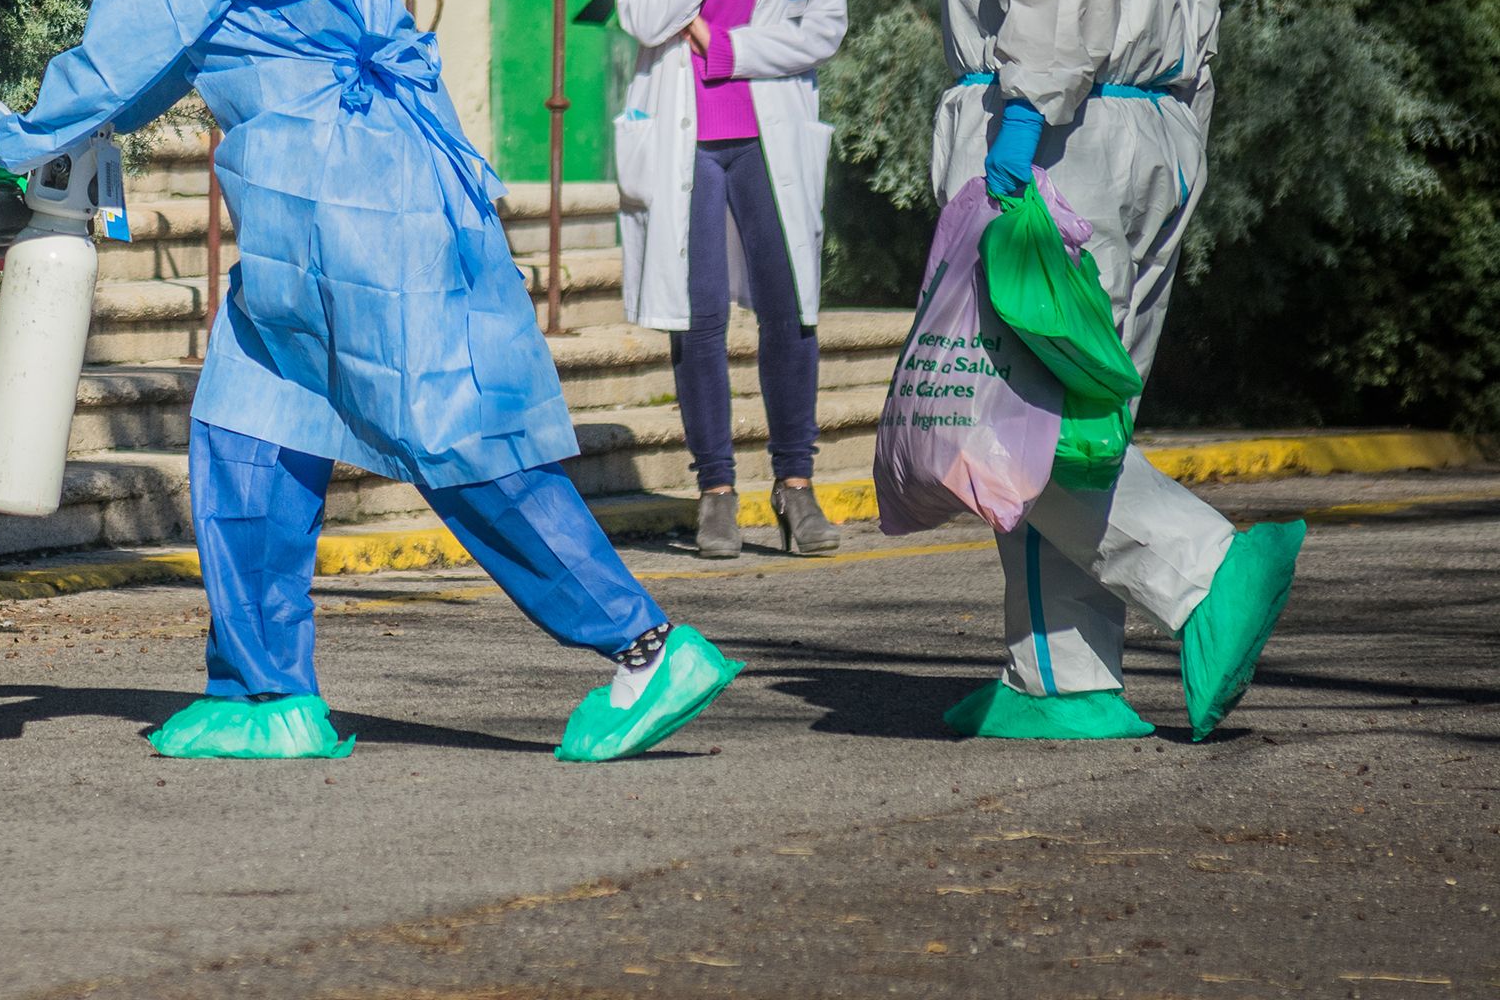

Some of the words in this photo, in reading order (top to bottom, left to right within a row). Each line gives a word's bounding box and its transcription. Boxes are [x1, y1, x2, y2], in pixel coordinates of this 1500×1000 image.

[971, 332, 1002, 352] del
[954, 357, 1011, 380] Salud
[900, 380, 913, 397] de
